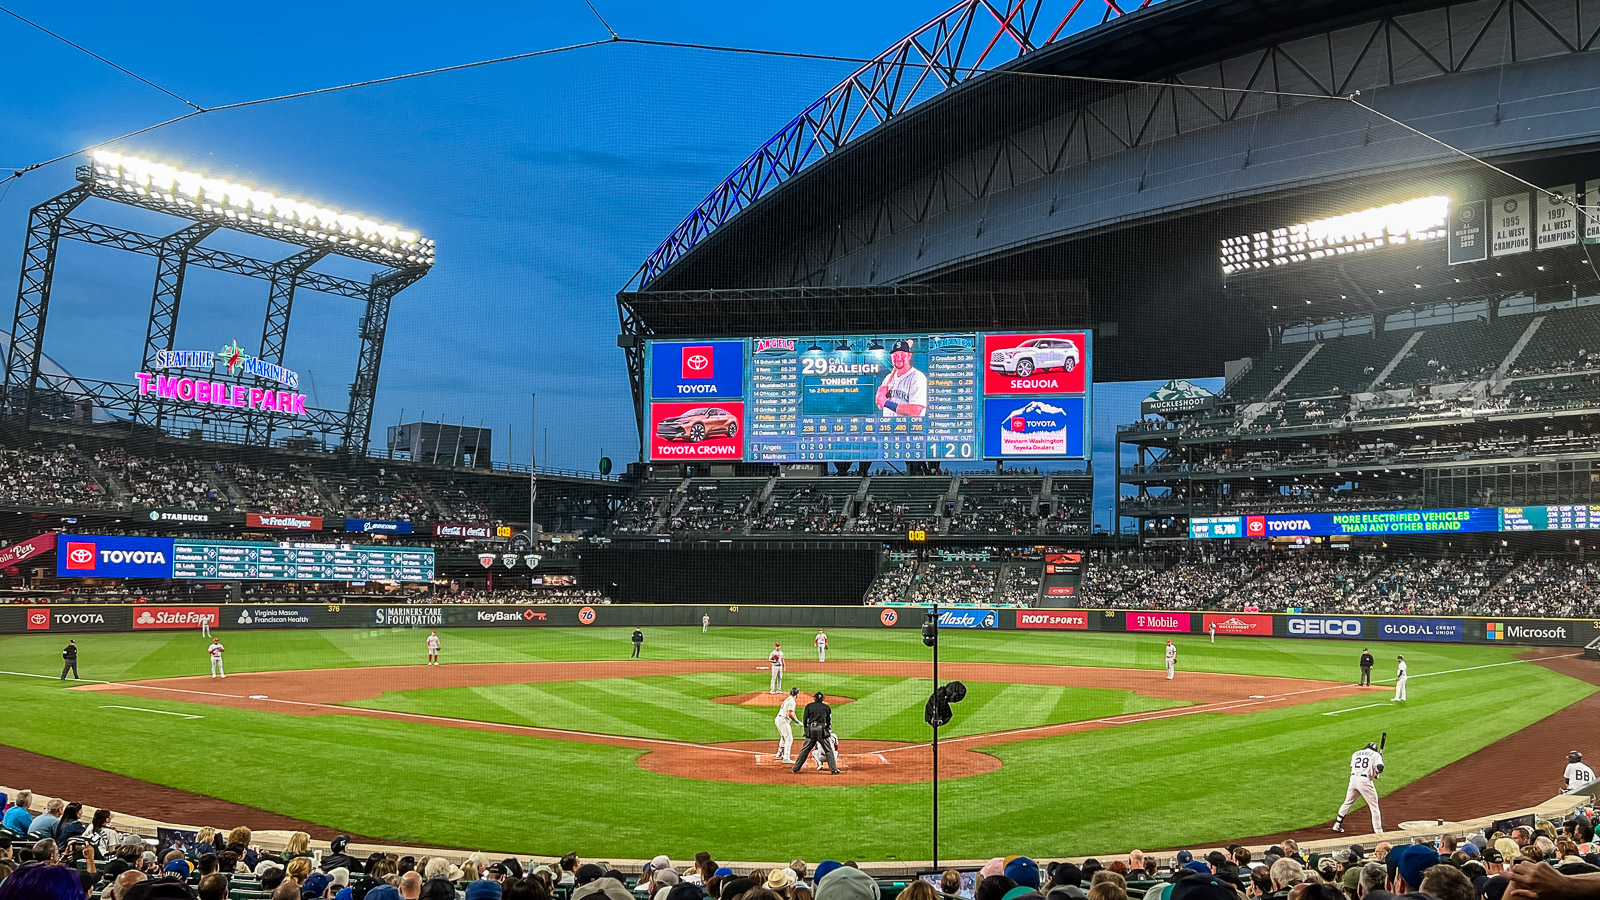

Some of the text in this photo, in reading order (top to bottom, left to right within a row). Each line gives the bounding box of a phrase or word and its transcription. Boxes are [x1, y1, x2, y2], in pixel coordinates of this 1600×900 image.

[1548, 208, 1566, 220] 1997
[1502, 216, 1520, 228] 1995
[1554, 220, 1572, 230] WEST
[1497, 228, 1526, 240] A.L. WEST
[1538, 230, 1576, 244] CHAMPIONS
[1494, 238, 1528, 252] CHAMPIONS
[757, 338, 794, 352] ANGELS
[156, 350, 299, 388] SEATTLE MARINERS
[802, 358, 828, 374] 29
[828, 364, 879, 373] RALEIGH
[677, 385, 717, 393] TOYOTA
[1010, 380, 1058, 388] SEQUOIA
[135, 372, 306, 414] T-MOBILE PARK
[1150, 398, 1205, 409] MUCKLESHOOT
[658, 446, 736, 455] TOYOTA CROWN
[930, 443, 971, 457] 1 2 0
[162, 513, 208, 522] STARBUCKS
[1333, 511, 1470, 524] MORE ELECTRIFIED VEHICLES
[1268, 520, 1311, 531] TOYOTA
[1342, 522, 1461, 532] THAN ANY OTHER BRAND
[497, 527, 511, 537] 0:03
[909, 531, 925, 541] 0:08
[100, 550, 166, 564] TOYOTA
[54, 614, 104, 624] TOYOTA
[376, 609, 384, 624] S
[388, 616, 442, 624] FOUNDATION
[478, 611, 522, 622] KeyBank
[581, 611, 593, 619] 76
[883, 612, 895, 622] 76
[938, 612, 975, 625] Alaska
[1022, 616, 1049, 624] ROOT
[1148, 616, 1178, 628] Mobile
[1288, 618, 1361, 635] GEICO
[1384, 625, 1433, 635] GLOBAL
[1507, 626, 1566, 639] Microsoft
[1355, 758, 1369, 768] 28
